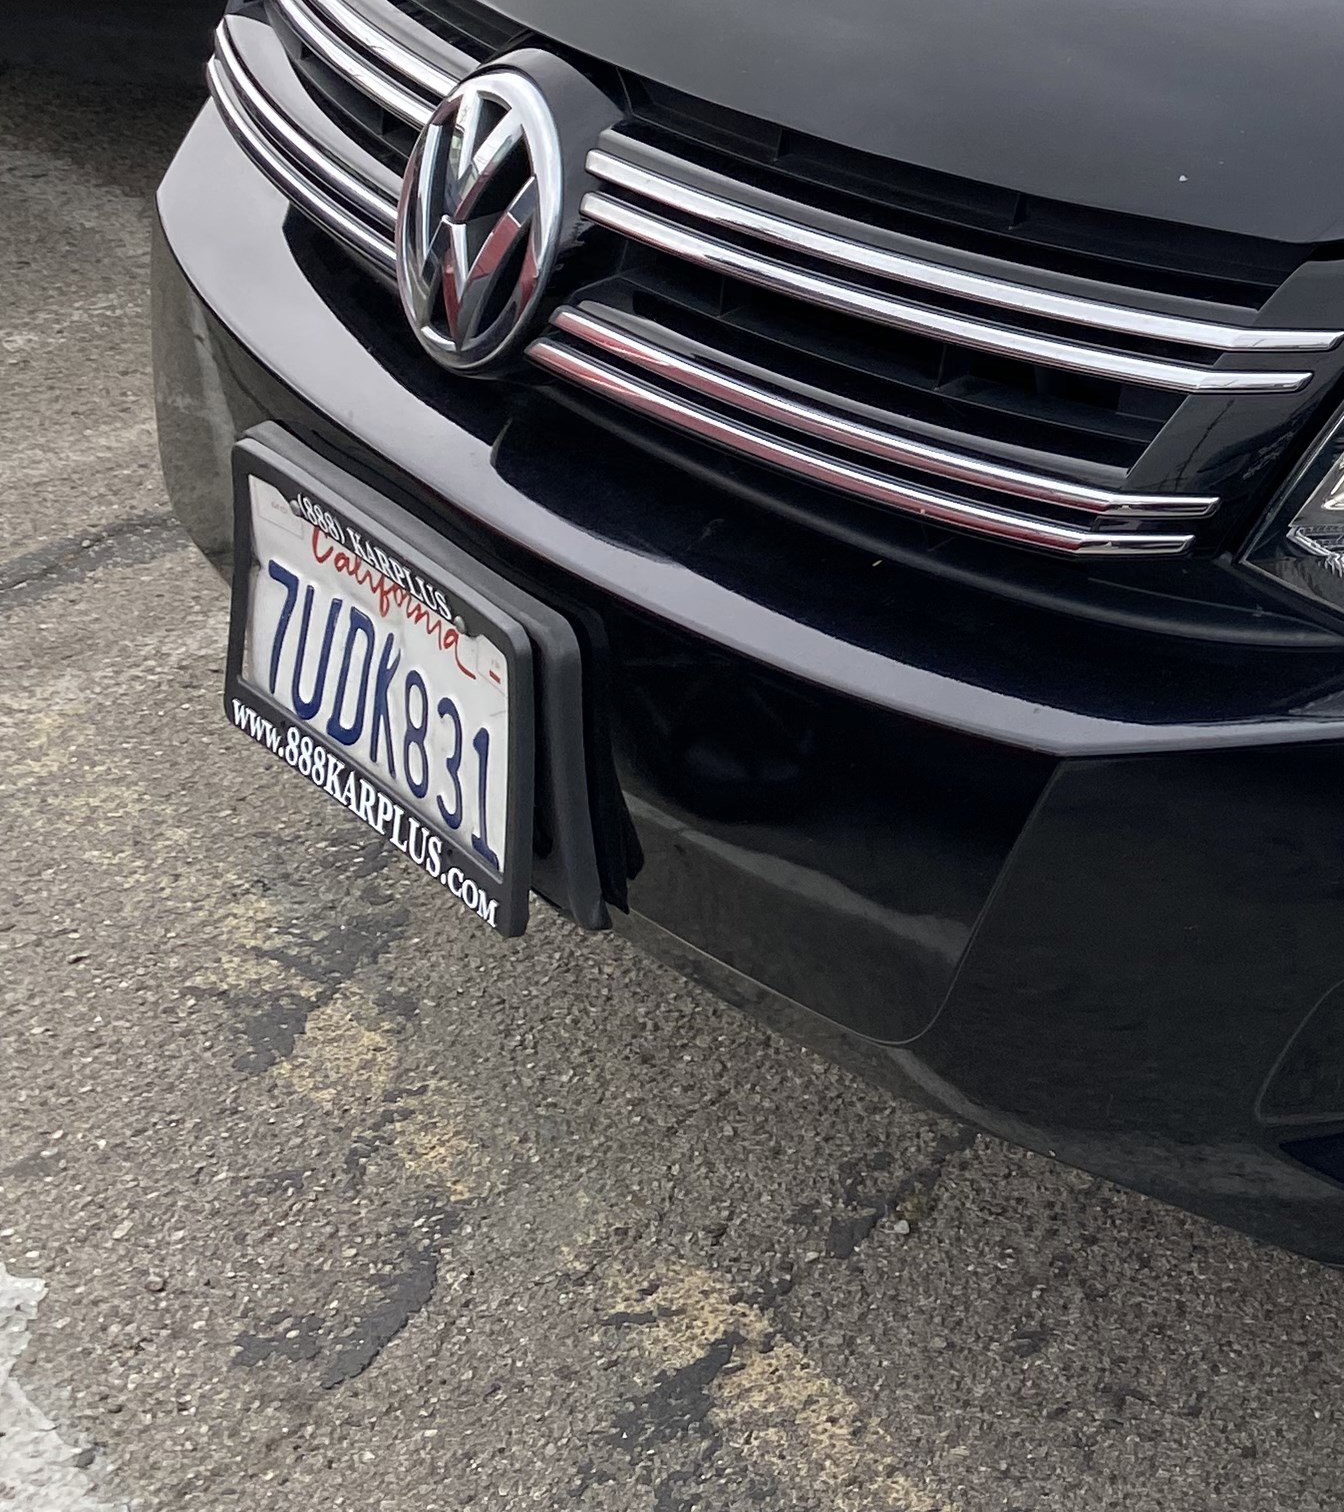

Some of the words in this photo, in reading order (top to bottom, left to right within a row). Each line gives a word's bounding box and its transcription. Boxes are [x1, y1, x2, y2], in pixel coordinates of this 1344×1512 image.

[298, 494, 345, 544] (888)
[347, 527, 451, 620] KARPLUS
[268, 559, 500, 870] 7UDK831
